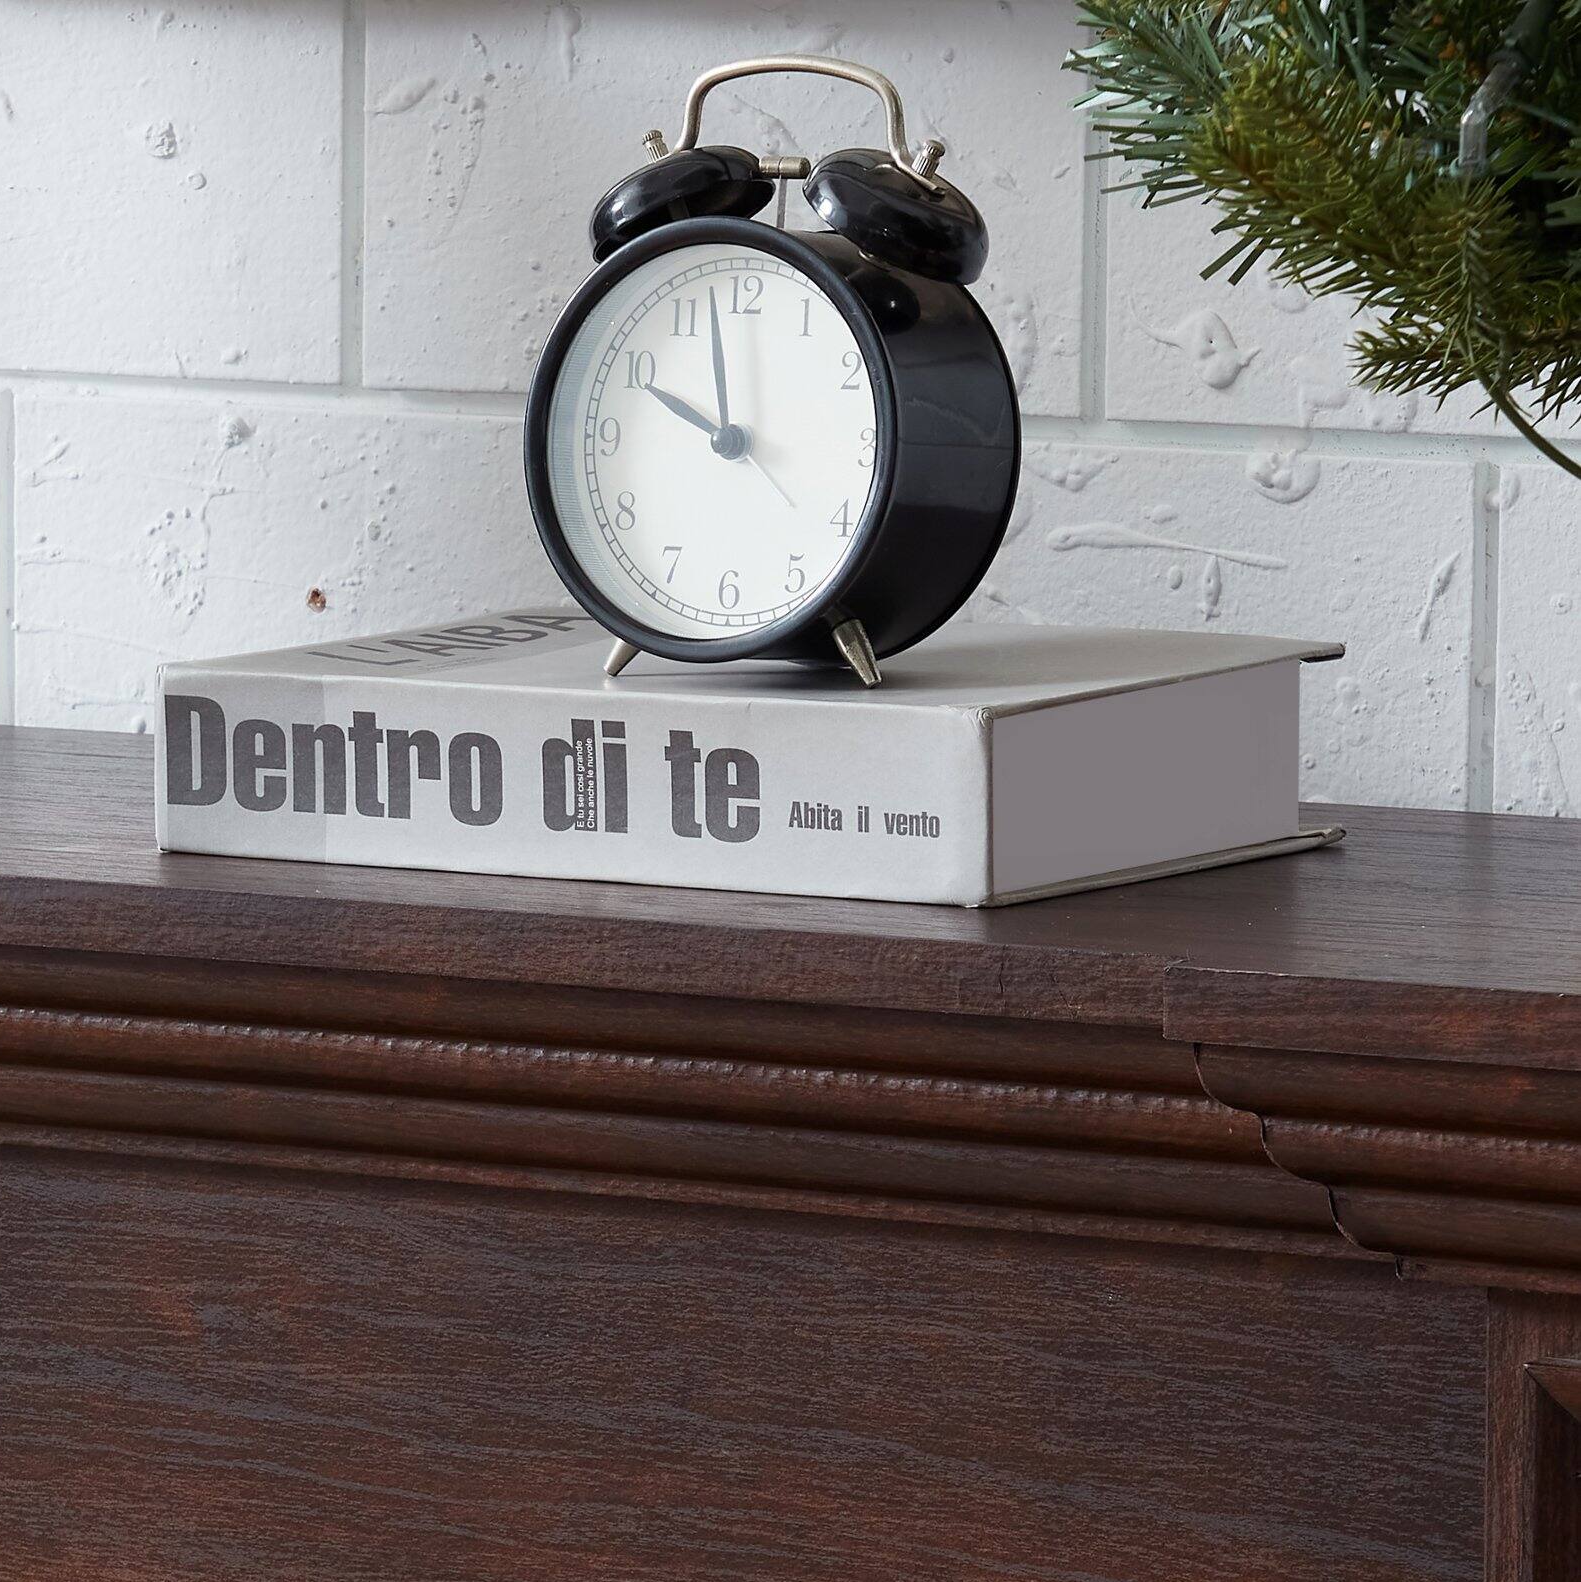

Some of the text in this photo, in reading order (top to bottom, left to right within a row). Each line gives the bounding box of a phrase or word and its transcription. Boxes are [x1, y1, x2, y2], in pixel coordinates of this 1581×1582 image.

[729, 275, 764, 316] 12
[669, 297, 699, 338] 11
[799, 297, 813, 338] 1
[624, 350, 657, 390] 10
[840, 350, 863, 391] 2
[599, 417, 622, 457] 9
[857, 427, 877, 469] 3
[615, 490, 636, 531] 8
[830, 498, 854, 538] 4
[662, 545, 683, 584] 7
[784, 554, 806, 594] 5
[718, 569, 740, 610] 6
[164, 693, 940, 844] Dentro di te Abita il vento
[575, 740, 586, 773] grande
[585, 737, 594, 767] nuvole
[586, 780, 595, 807] anche
